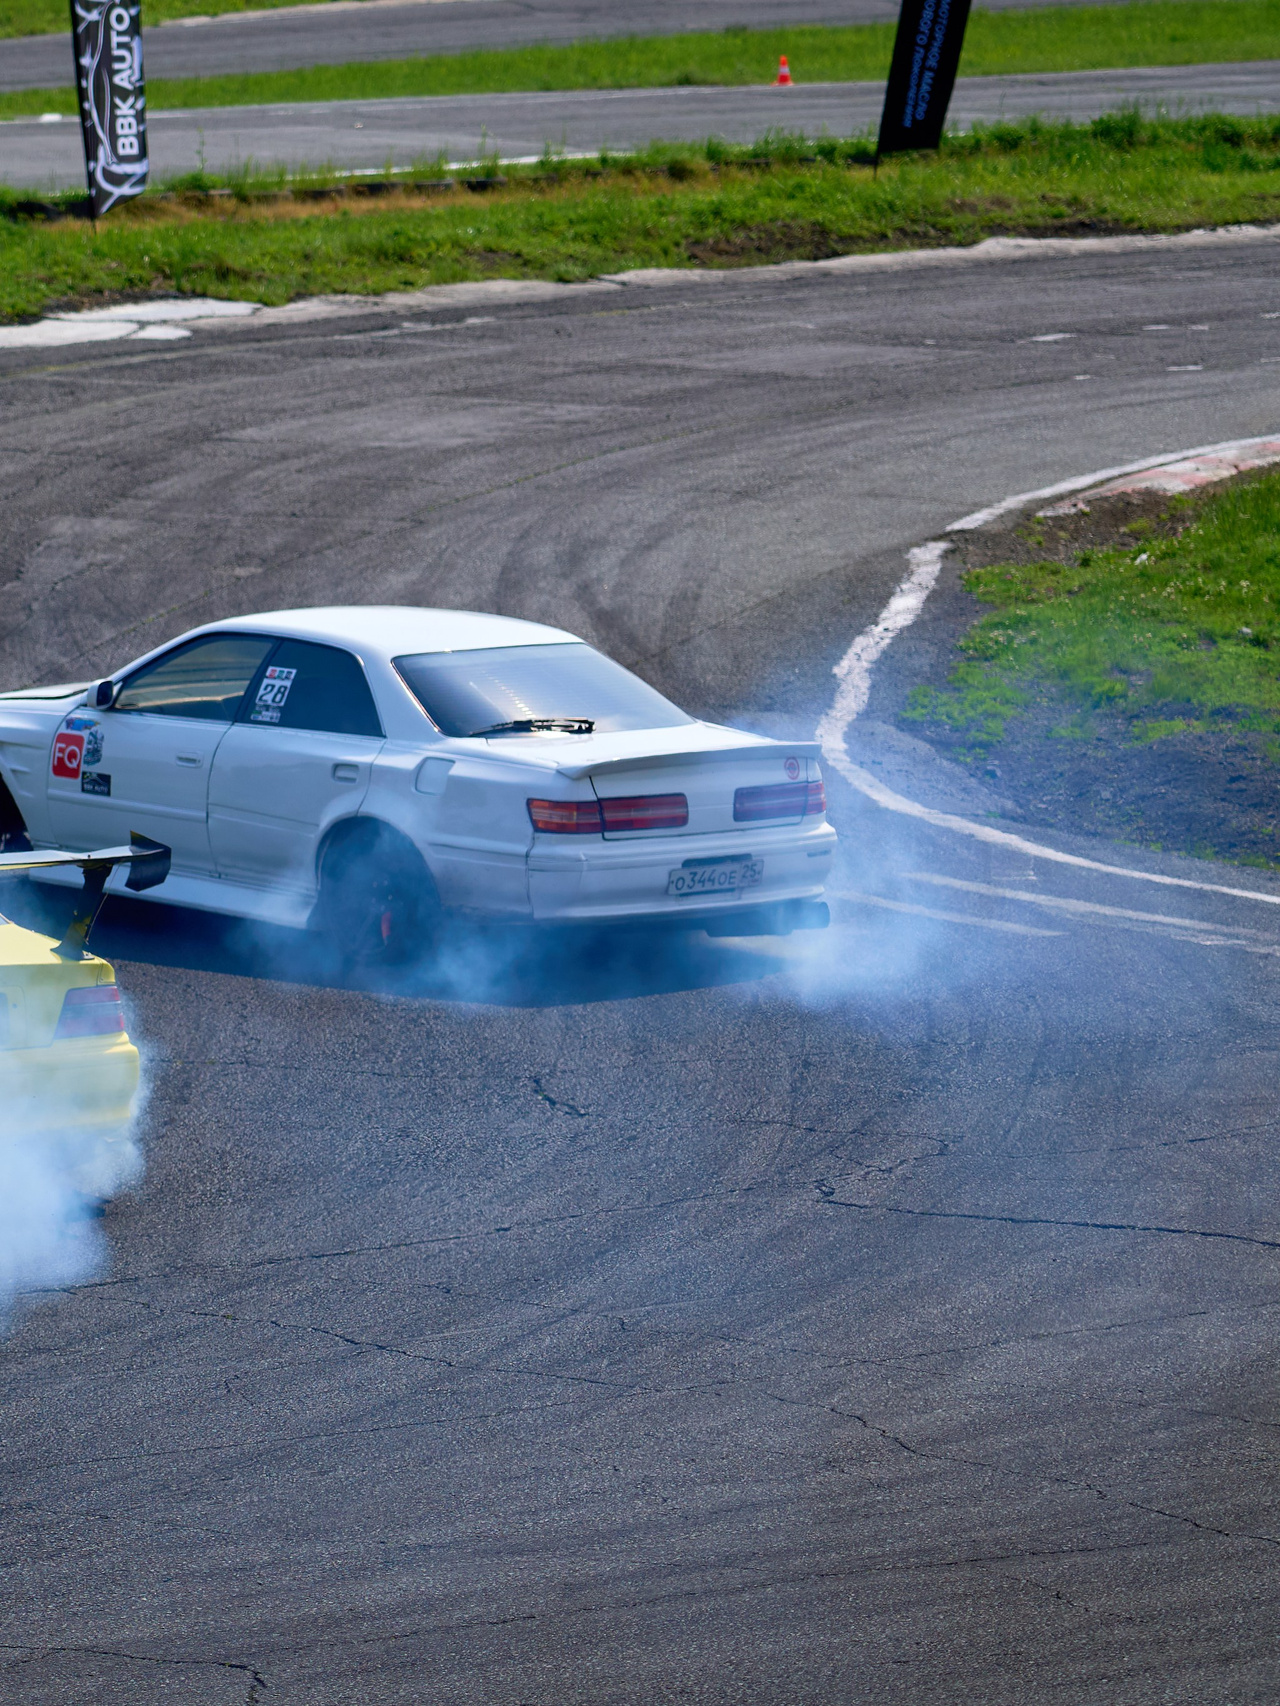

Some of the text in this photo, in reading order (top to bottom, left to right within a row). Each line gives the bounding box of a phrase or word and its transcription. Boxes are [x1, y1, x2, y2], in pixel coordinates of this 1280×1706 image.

[109, 6, 140, 157] BBK AUTO
[914, 69, 936, 121] МАСЛО
[258, 683, 288, 704] 28
[53, 742, 81, 769] FQ
[742, 863, 758, 879] 25
